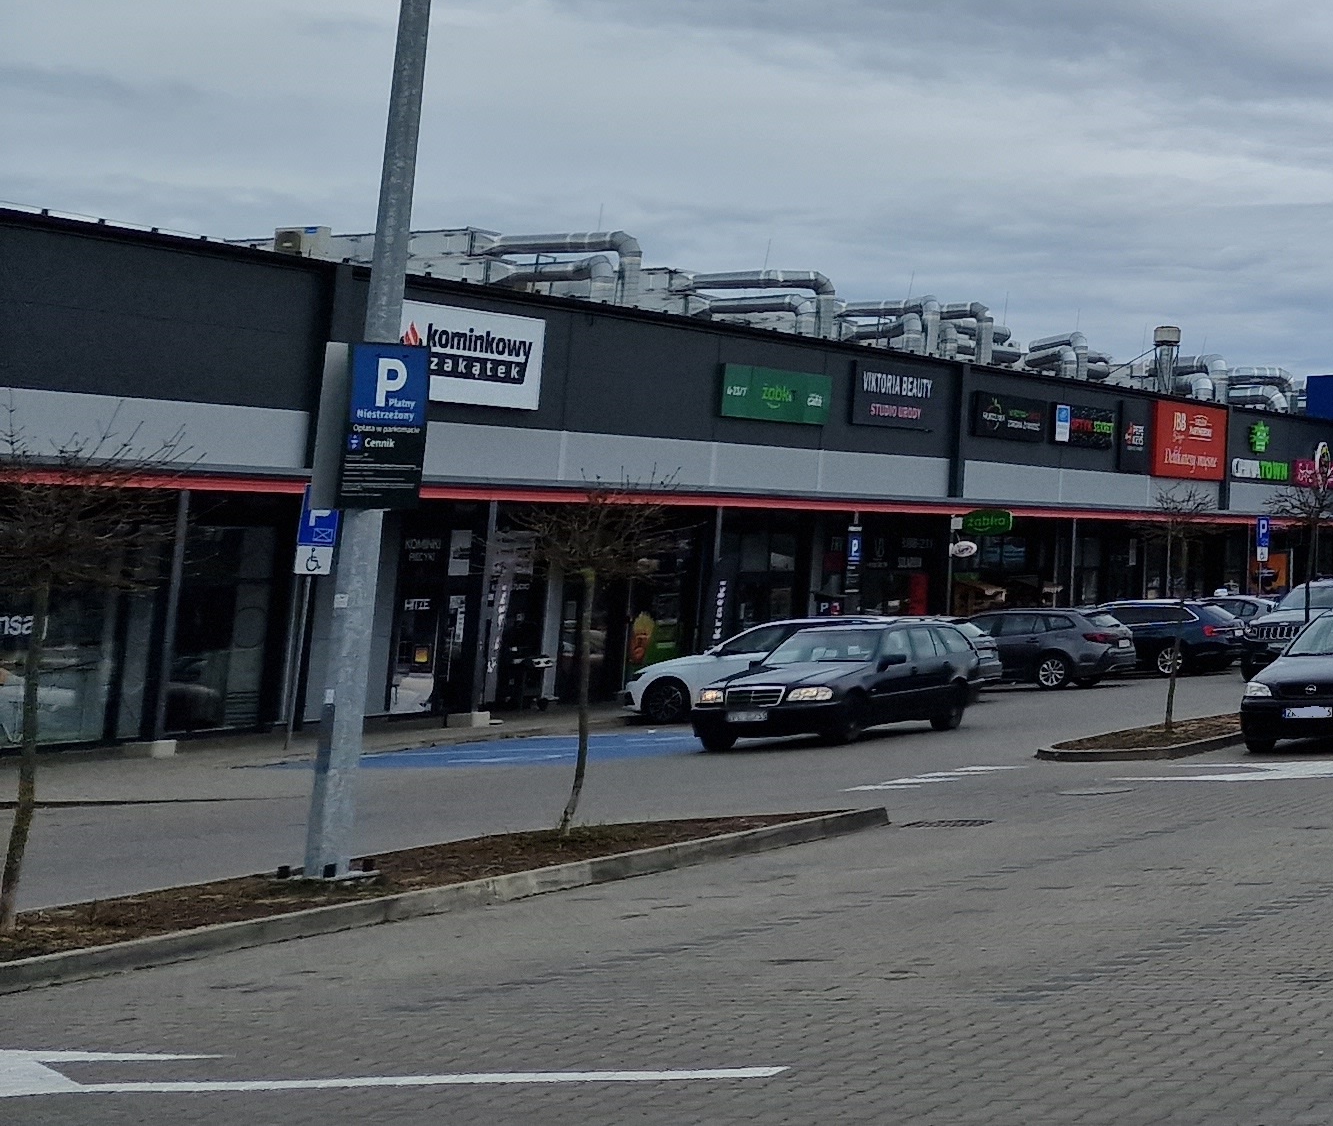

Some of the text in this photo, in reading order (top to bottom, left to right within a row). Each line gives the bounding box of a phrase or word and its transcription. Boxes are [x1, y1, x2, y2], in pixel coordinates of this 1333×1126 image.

[426, 323, 533, 360] kominkowy
[429, 357, 520, 379] zakątek
[375, 357, 407, 407] P
[863, 371, 933, 398] VIKTORIA BEAUTY
[870, 403, 897, 417] STUDIO
[364, 437, 395, 448] Cennik
